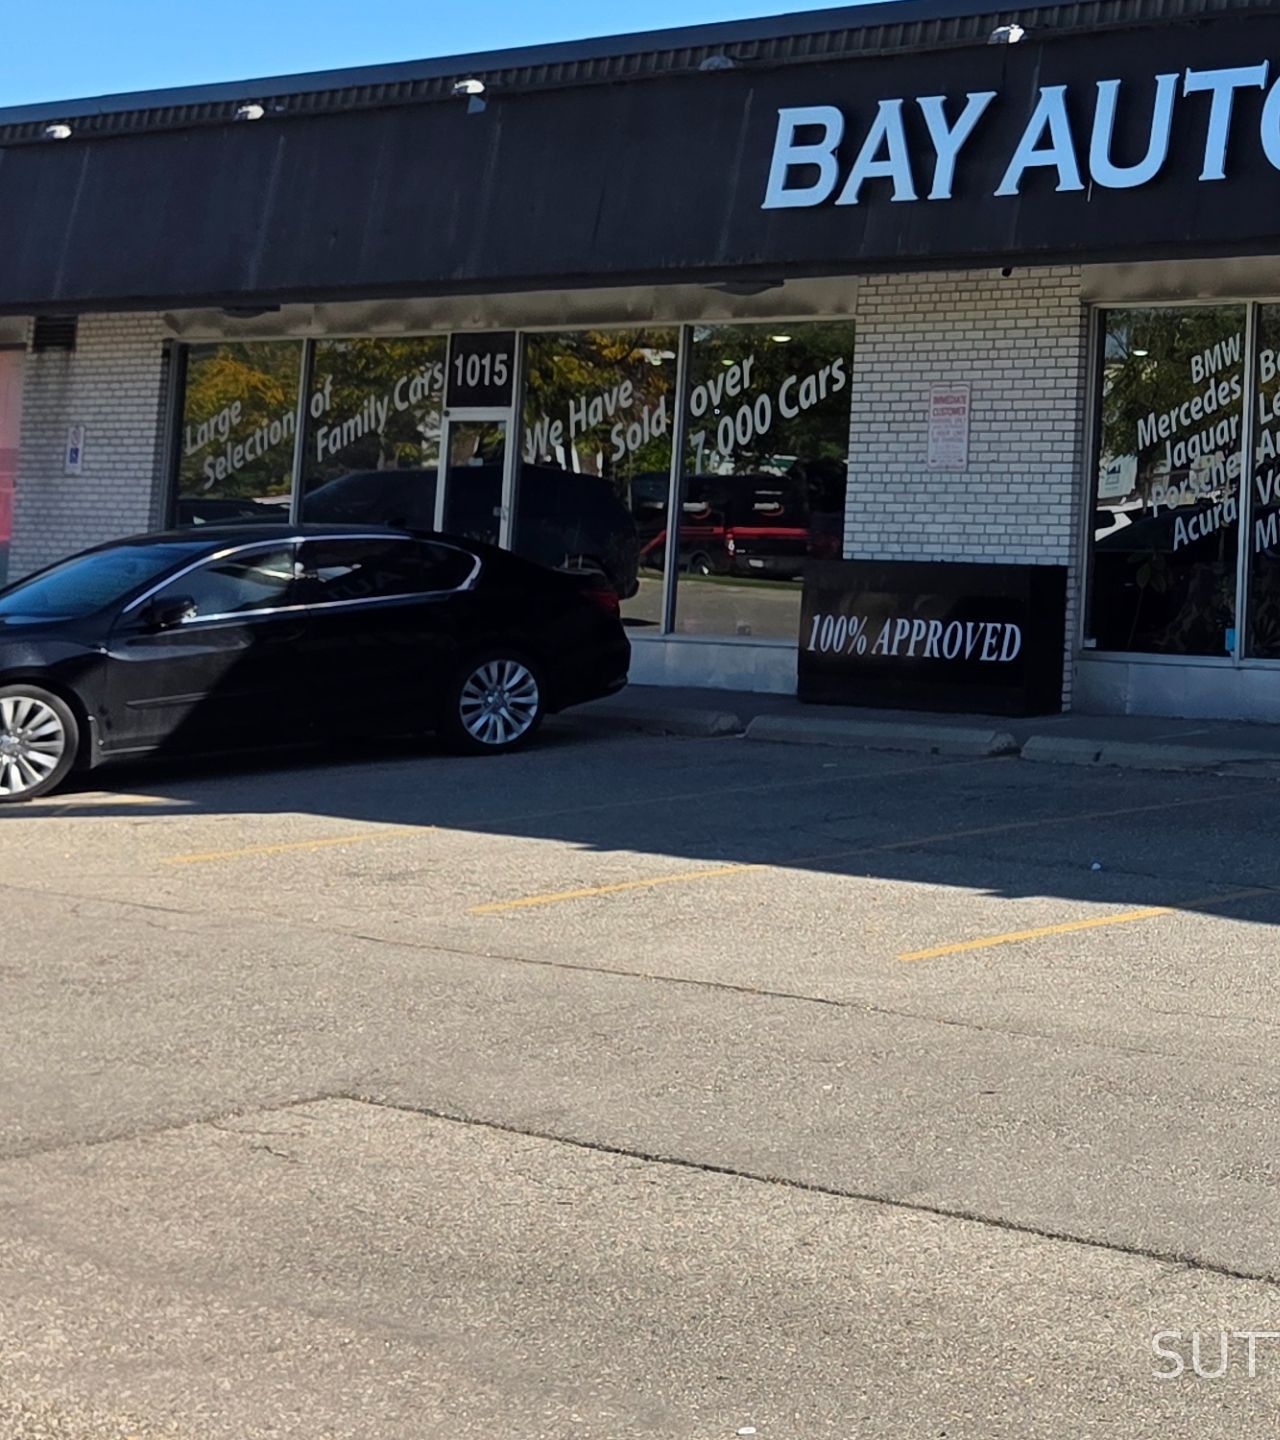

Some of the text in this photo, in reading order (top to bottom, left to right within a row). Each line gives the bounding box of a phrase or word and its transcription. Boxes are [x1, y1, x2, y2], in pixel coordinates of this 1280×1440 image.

[761, 91, 997, 210] BAY
[453, 352, 509, 388] 1015
[778, 357, 846, 420] Cars
[1190, 332, 1241, 384] BMW
[184, 400, 242, 457] Large
[202, 374, 334, 491] Selection of
[316, 361, 444, 463] Family Cars
[526, 380, 633, 463] We Have
[610, 356, 754, 461] Sold over
[1137, 374, 1242, 451] Mercedes
[1158, 414, 1239, 474] Jaguar
[1151, 450, 1242, 518] Porsche
[1173, 496, 1238, 552] Acura
[806, 614, 1022, 662] 100% APPROVED
